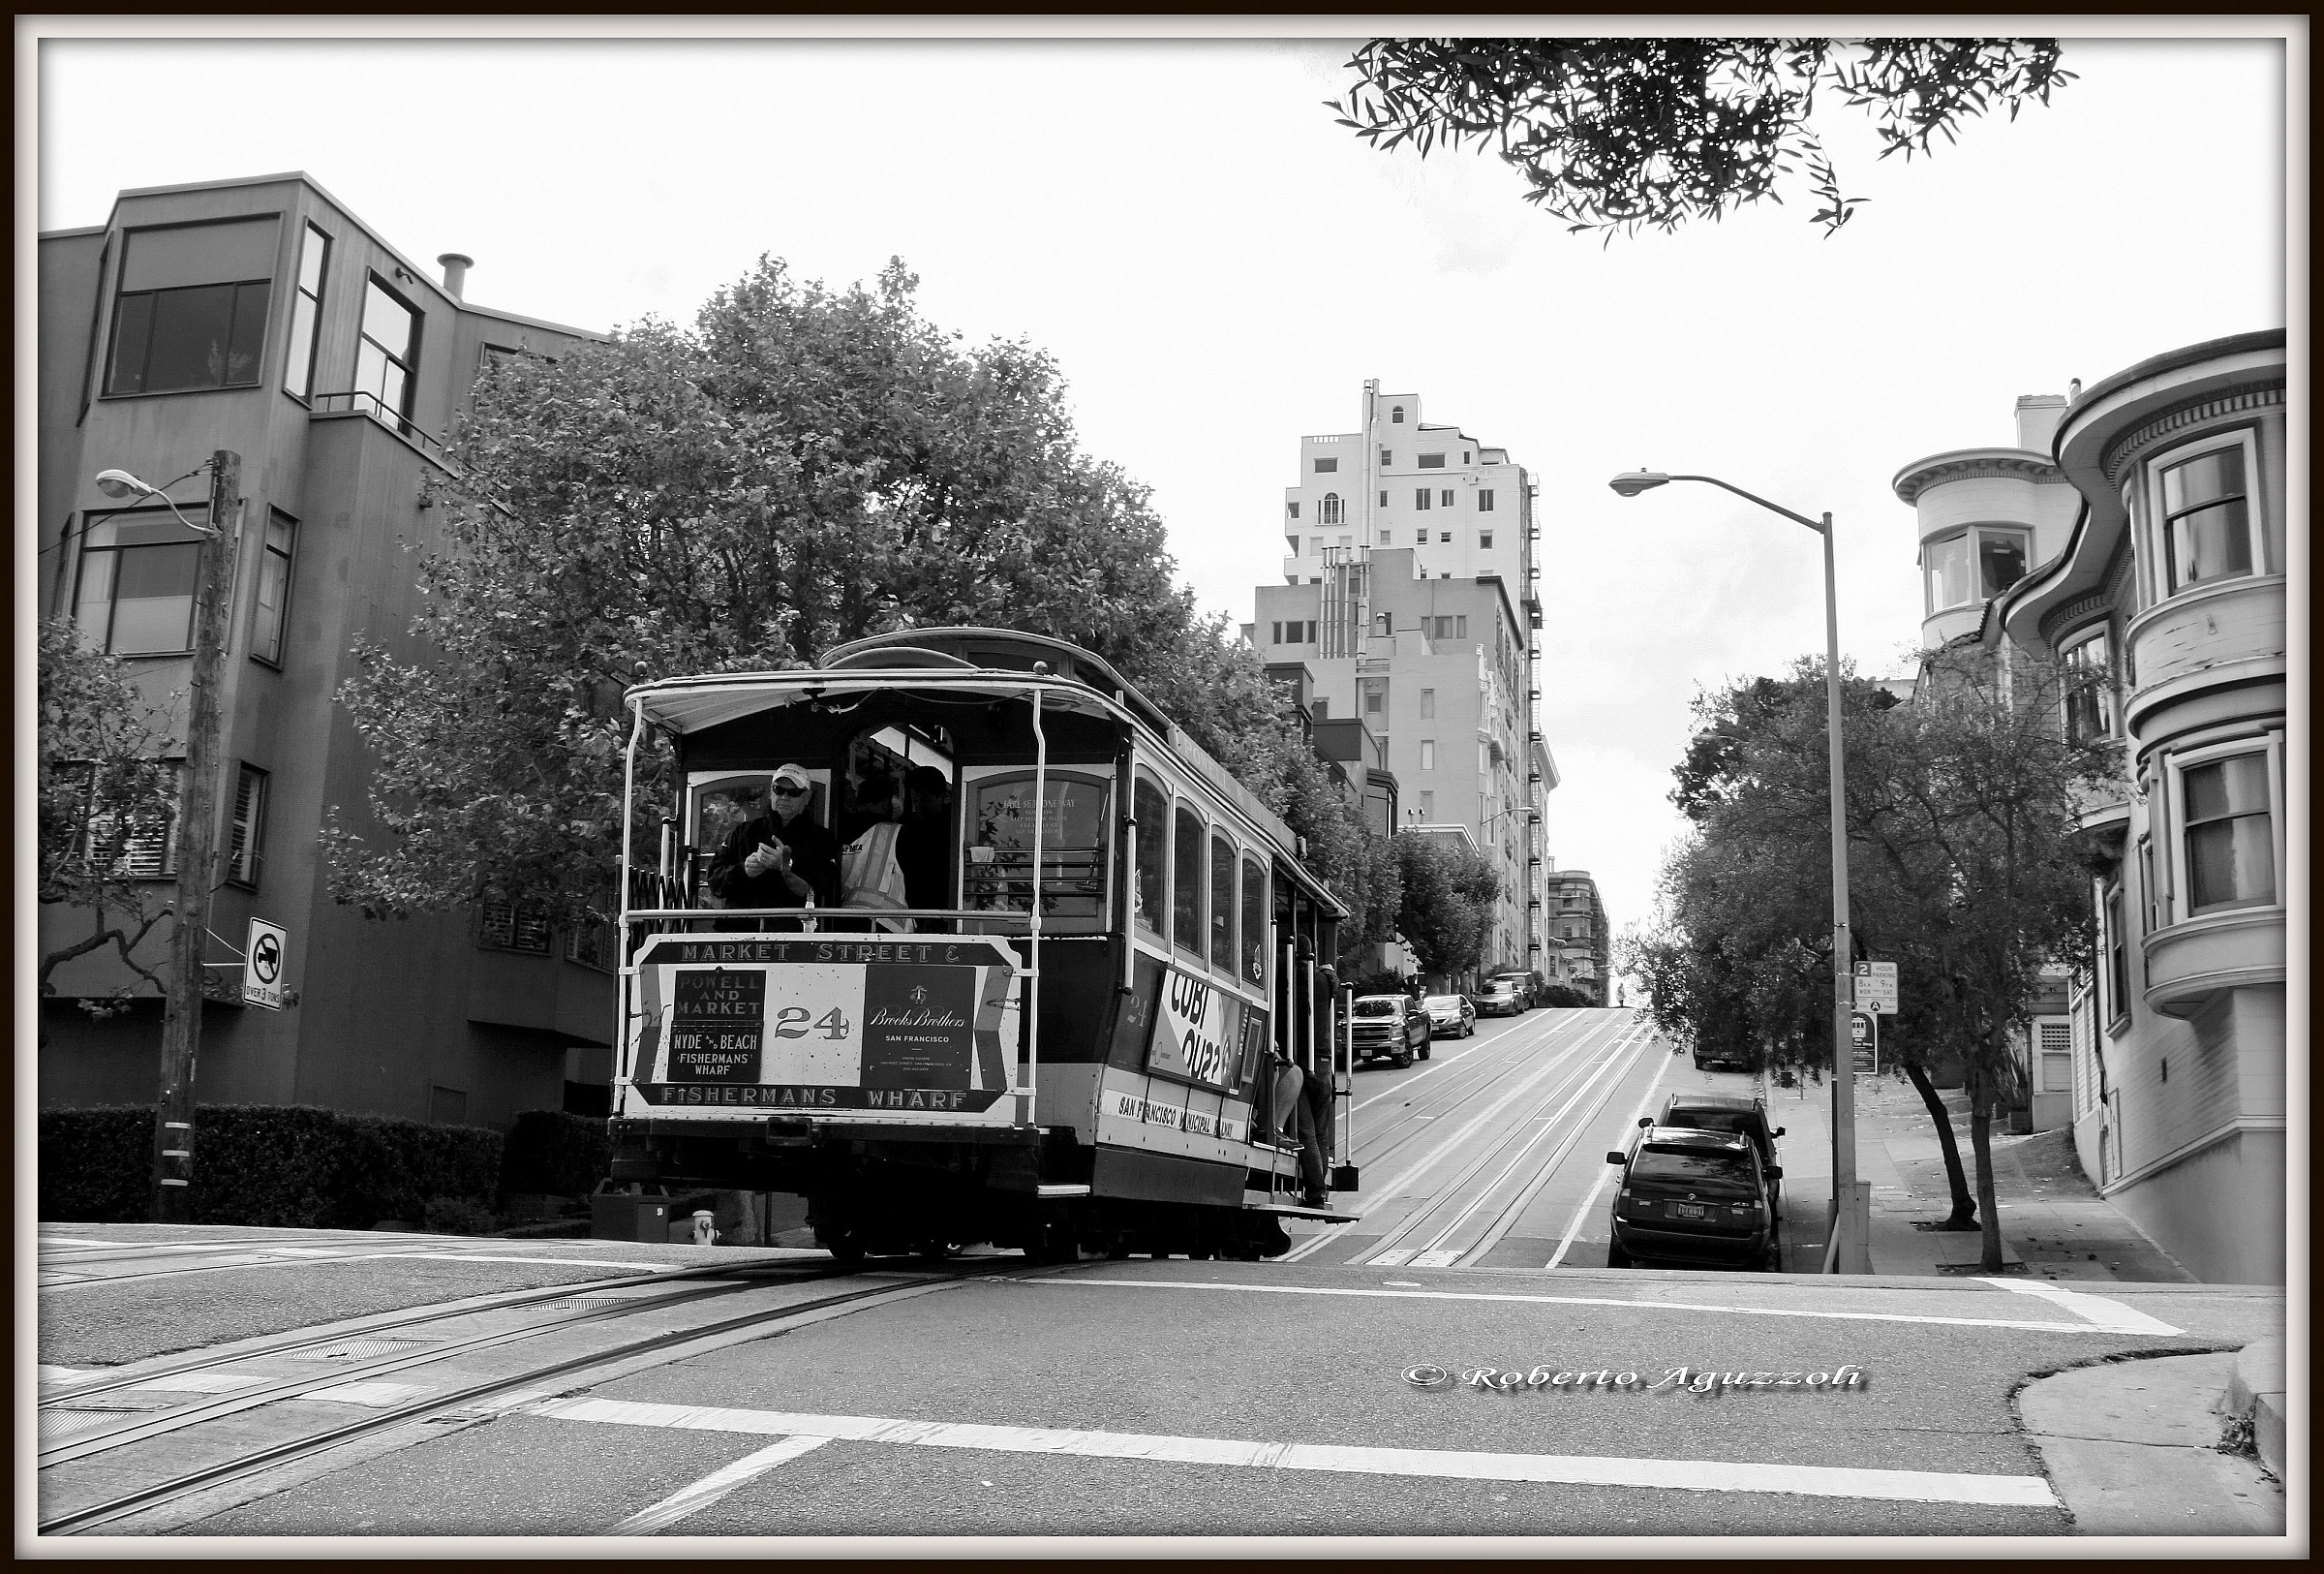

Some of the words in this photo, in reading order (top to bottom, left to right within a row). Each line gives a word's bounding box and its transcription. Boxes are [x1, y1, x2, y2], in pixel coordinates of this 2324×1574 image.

[682, 943, 790, 962] MARKET
[816, 943, 933, 963] STREET
[1859, 964, 1868, 975] 2
[680, 975, 760, 989] POWELL
[261, 987, 267, 1001] 3
[699, 990, 740, 1001] AND
[677, 1002, 760, 1015] MARKET
[1127, 995, 1147, 1027] 24
[775, 1006, 849, 1040] 24
[870, 1005, 912, 1026] Brooks
[912, 1006, 964, 1028] Brothers
[674, 1034, 702, 1050] HYDE
[719, 1034, 757, 1050] BEACH
[903, 1034, 950, 1043] FRANCISCO
[694, 1065, 731, 1075] WHARF
[661, 1086, 837, 1105] FISHERMANS
[866, 1090, 967, 1110] WHARF
[1118, 1096, 1137, 1117] SAN
